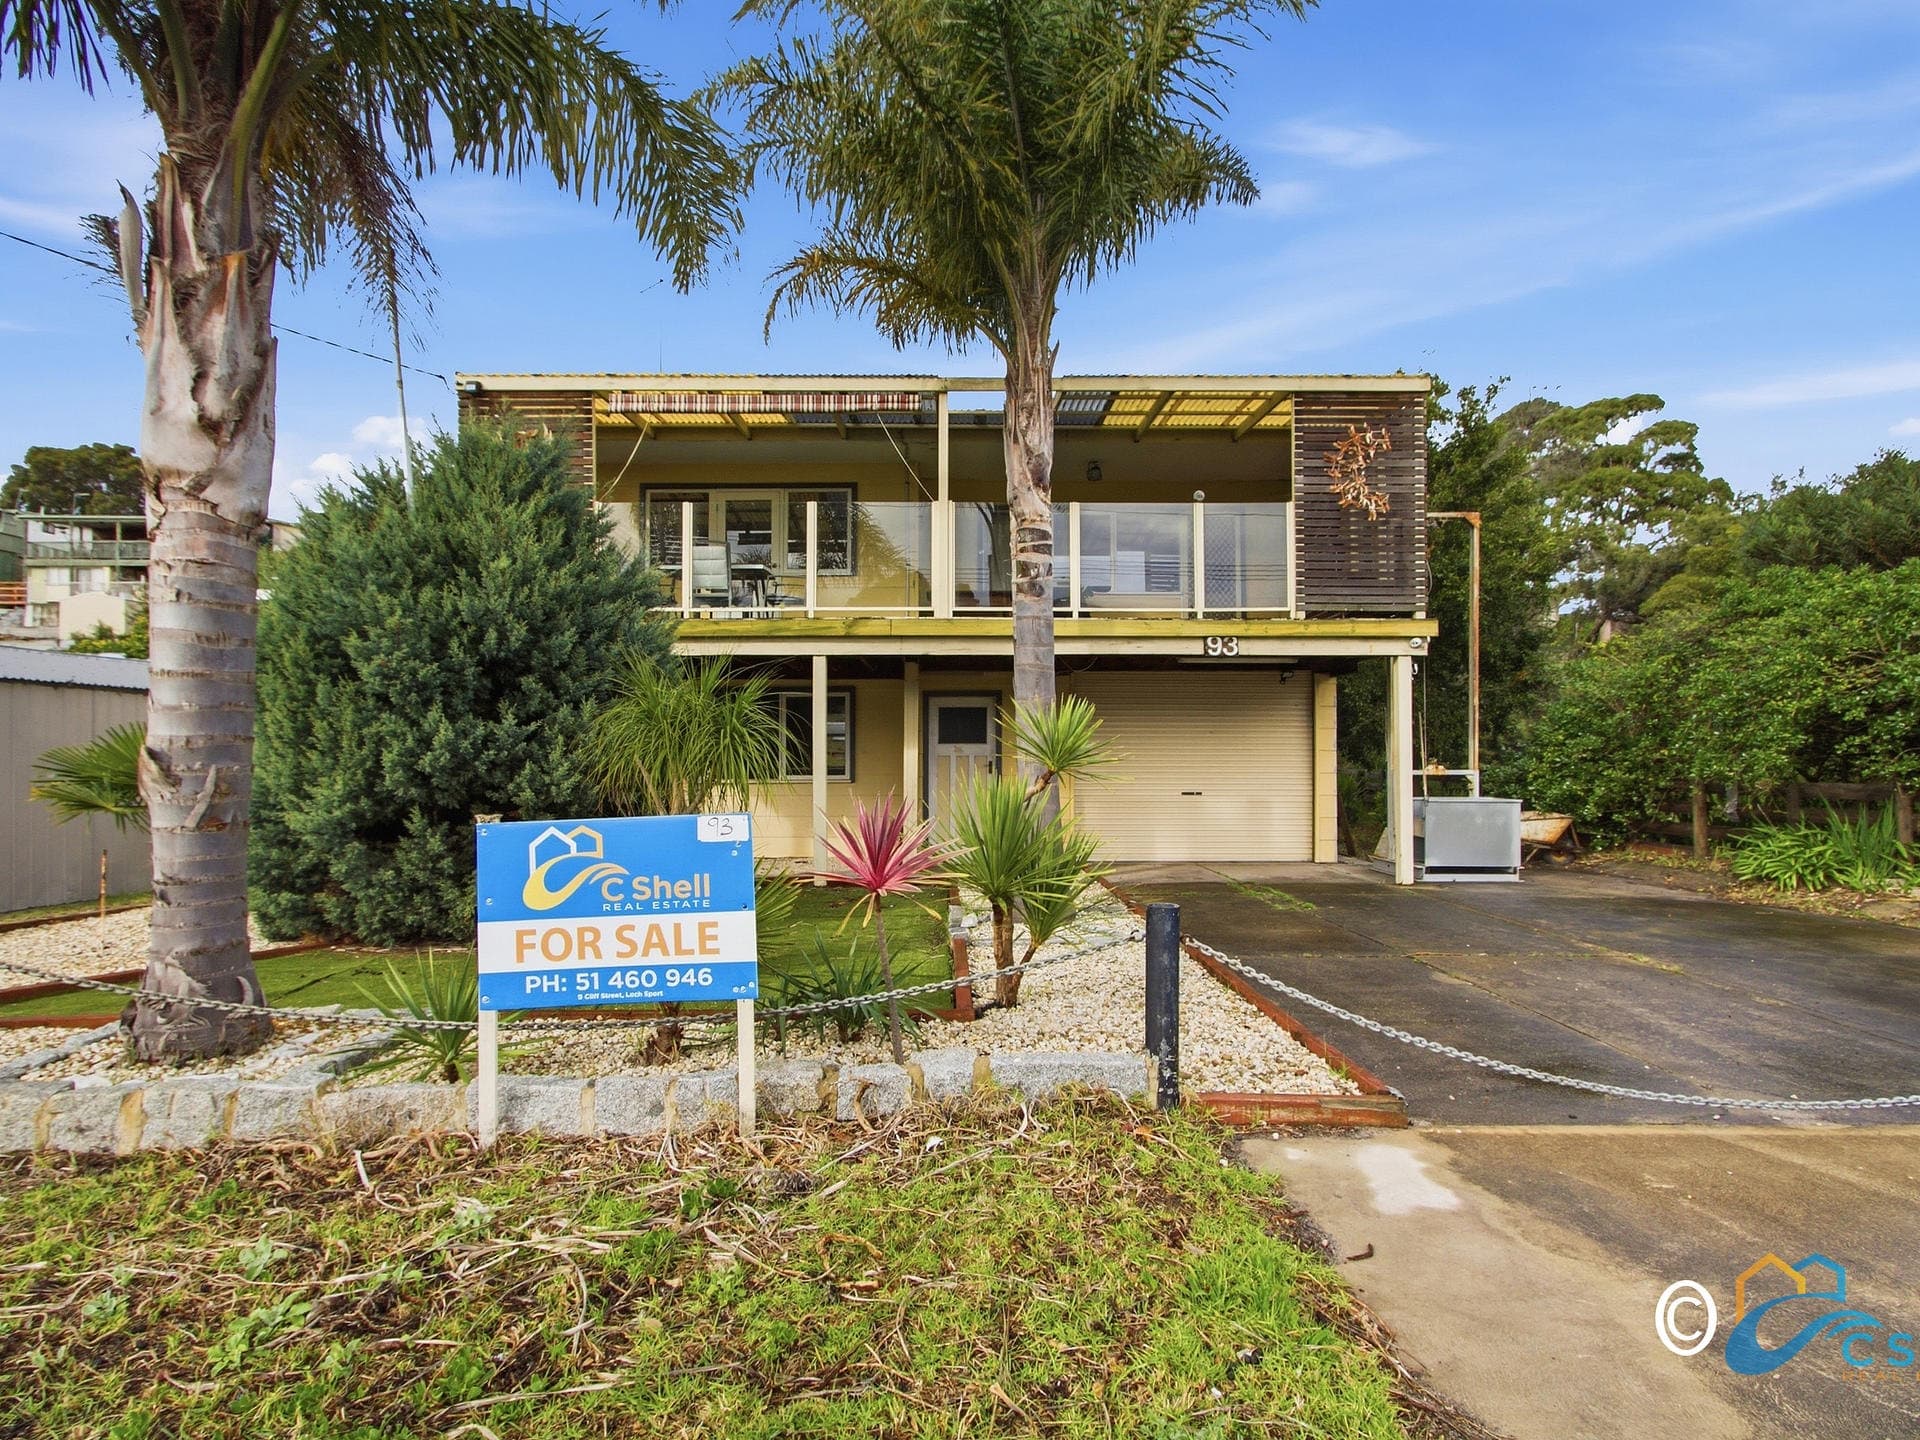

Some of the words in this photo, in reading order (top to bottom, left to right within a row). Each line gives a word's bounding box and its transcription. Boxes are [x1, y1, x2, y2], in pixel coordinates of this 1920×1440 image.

[1206, 636, 1238, 656] 93
[707, 816, 734, 836] 93
[601, 877, 625, 901] C
[632, 873, 710, 901] Shell
[602, 902, 644, 911] REAL
[652, 899, 711, 910] ESTATE
[515, 926, 602, 963] FOR
[615, 921, 721, 959] SALE
[525, 974, 567, 994] PH:
[576, 972, 600, 991] 51
[607, 970, 657, 990] 460
[666, 968, 713, 988] 946
